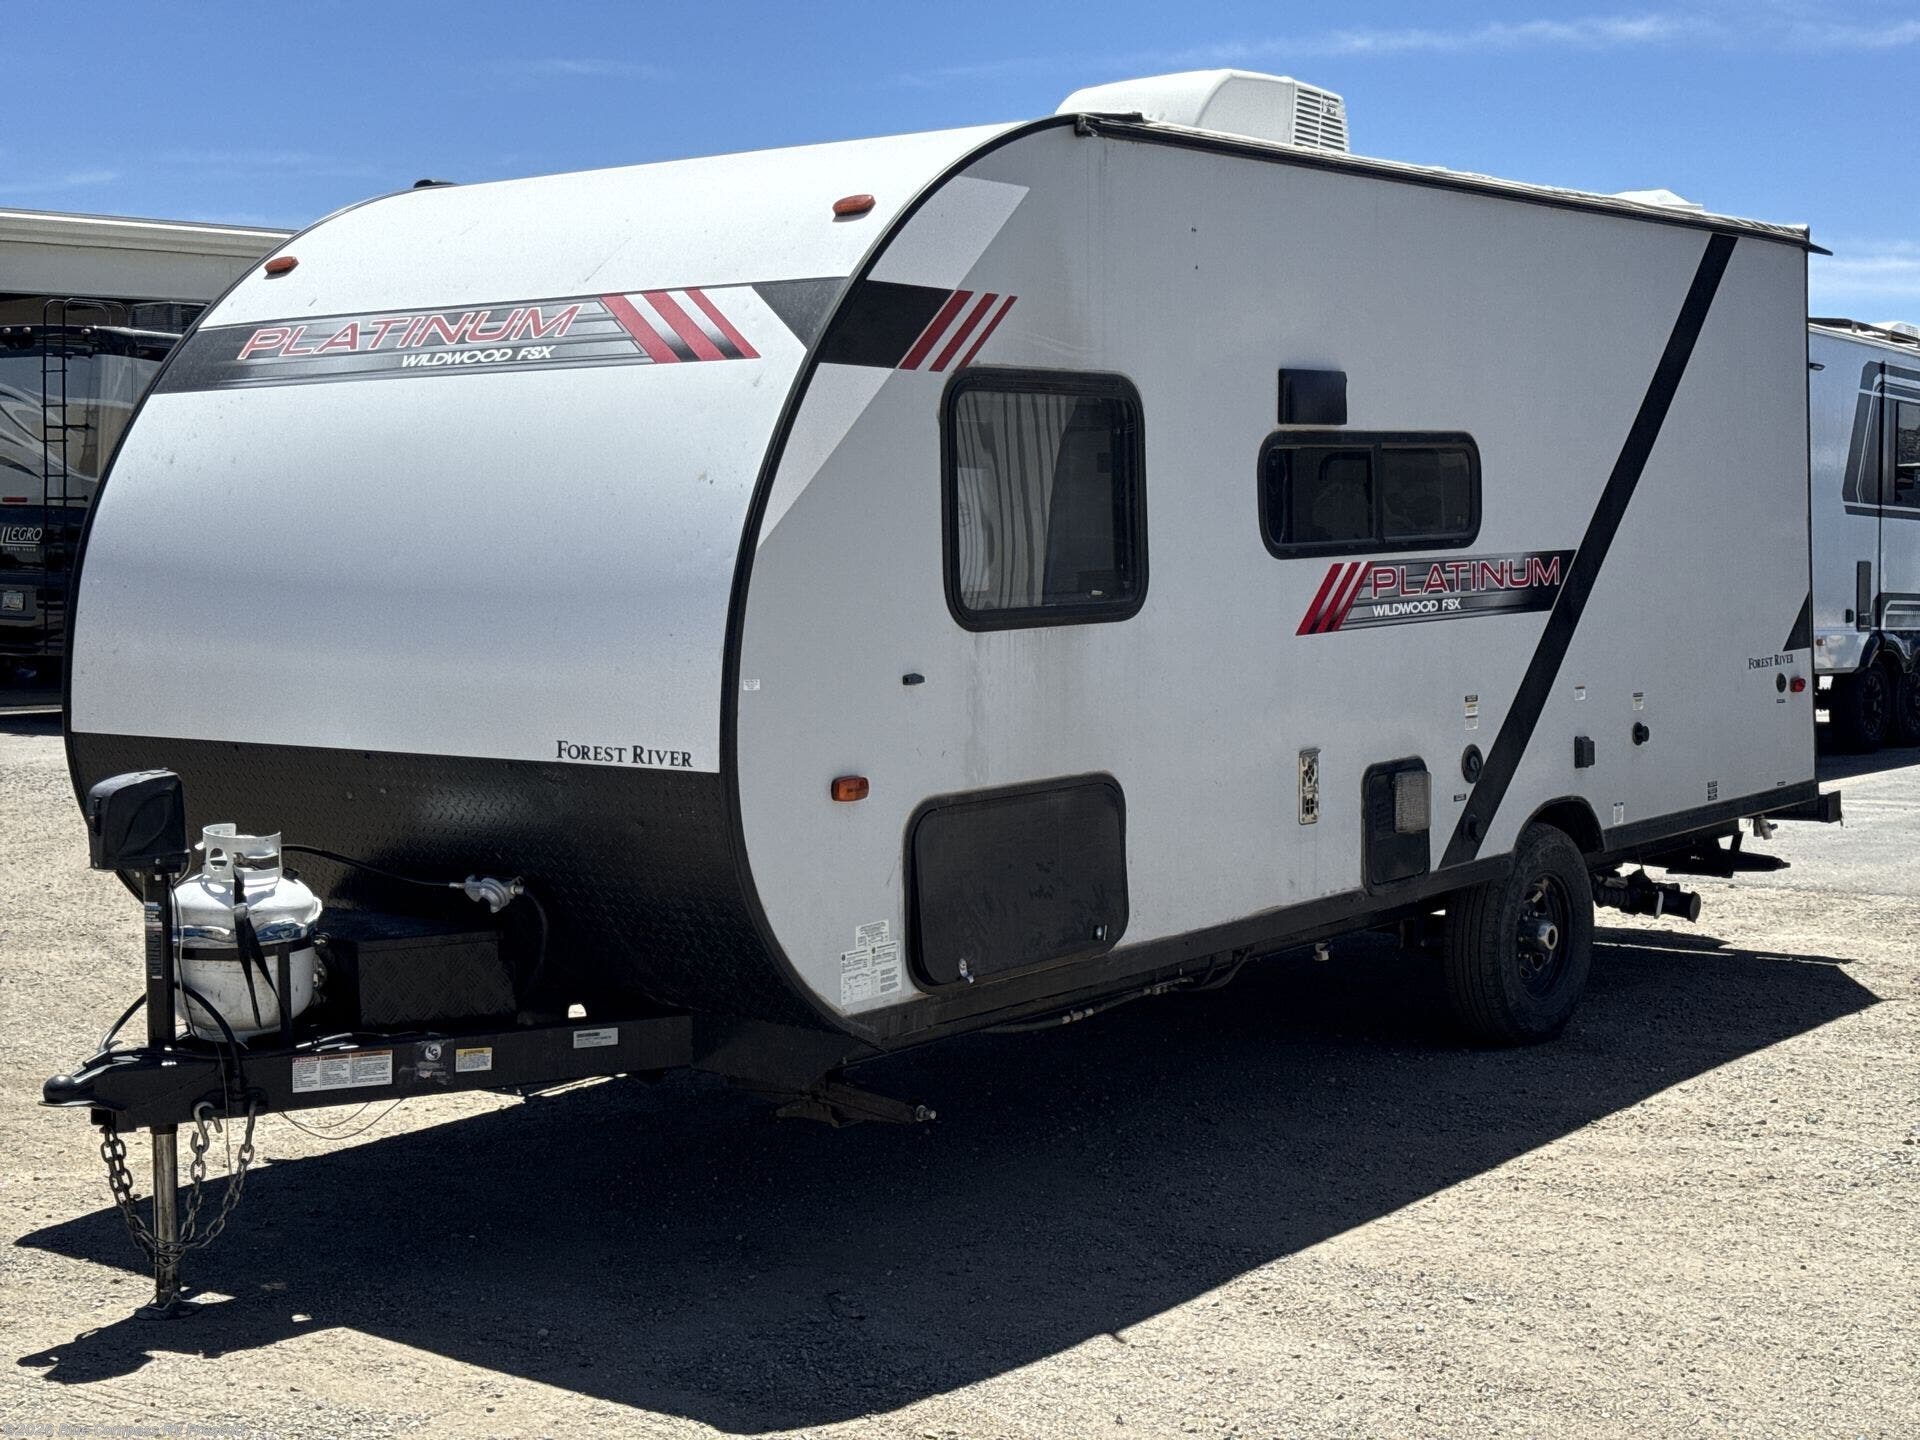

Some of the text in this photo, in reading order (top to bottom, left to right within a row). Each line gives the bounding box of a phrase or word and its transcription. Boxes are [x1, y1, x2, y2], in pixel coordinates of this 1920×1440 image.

[237, 304, 583, 360] PLATINUM
[401, 346, 556, 368] WILDWOOD FSX
[1371, 556, 1560, 599] PLATINUM
[1373, 598, 1461, 617] WILDWOOD FSX
[1748, 654, 1794, 669] FOREST RIVER
[556, 740, 693, 767] FOREST RIVER
